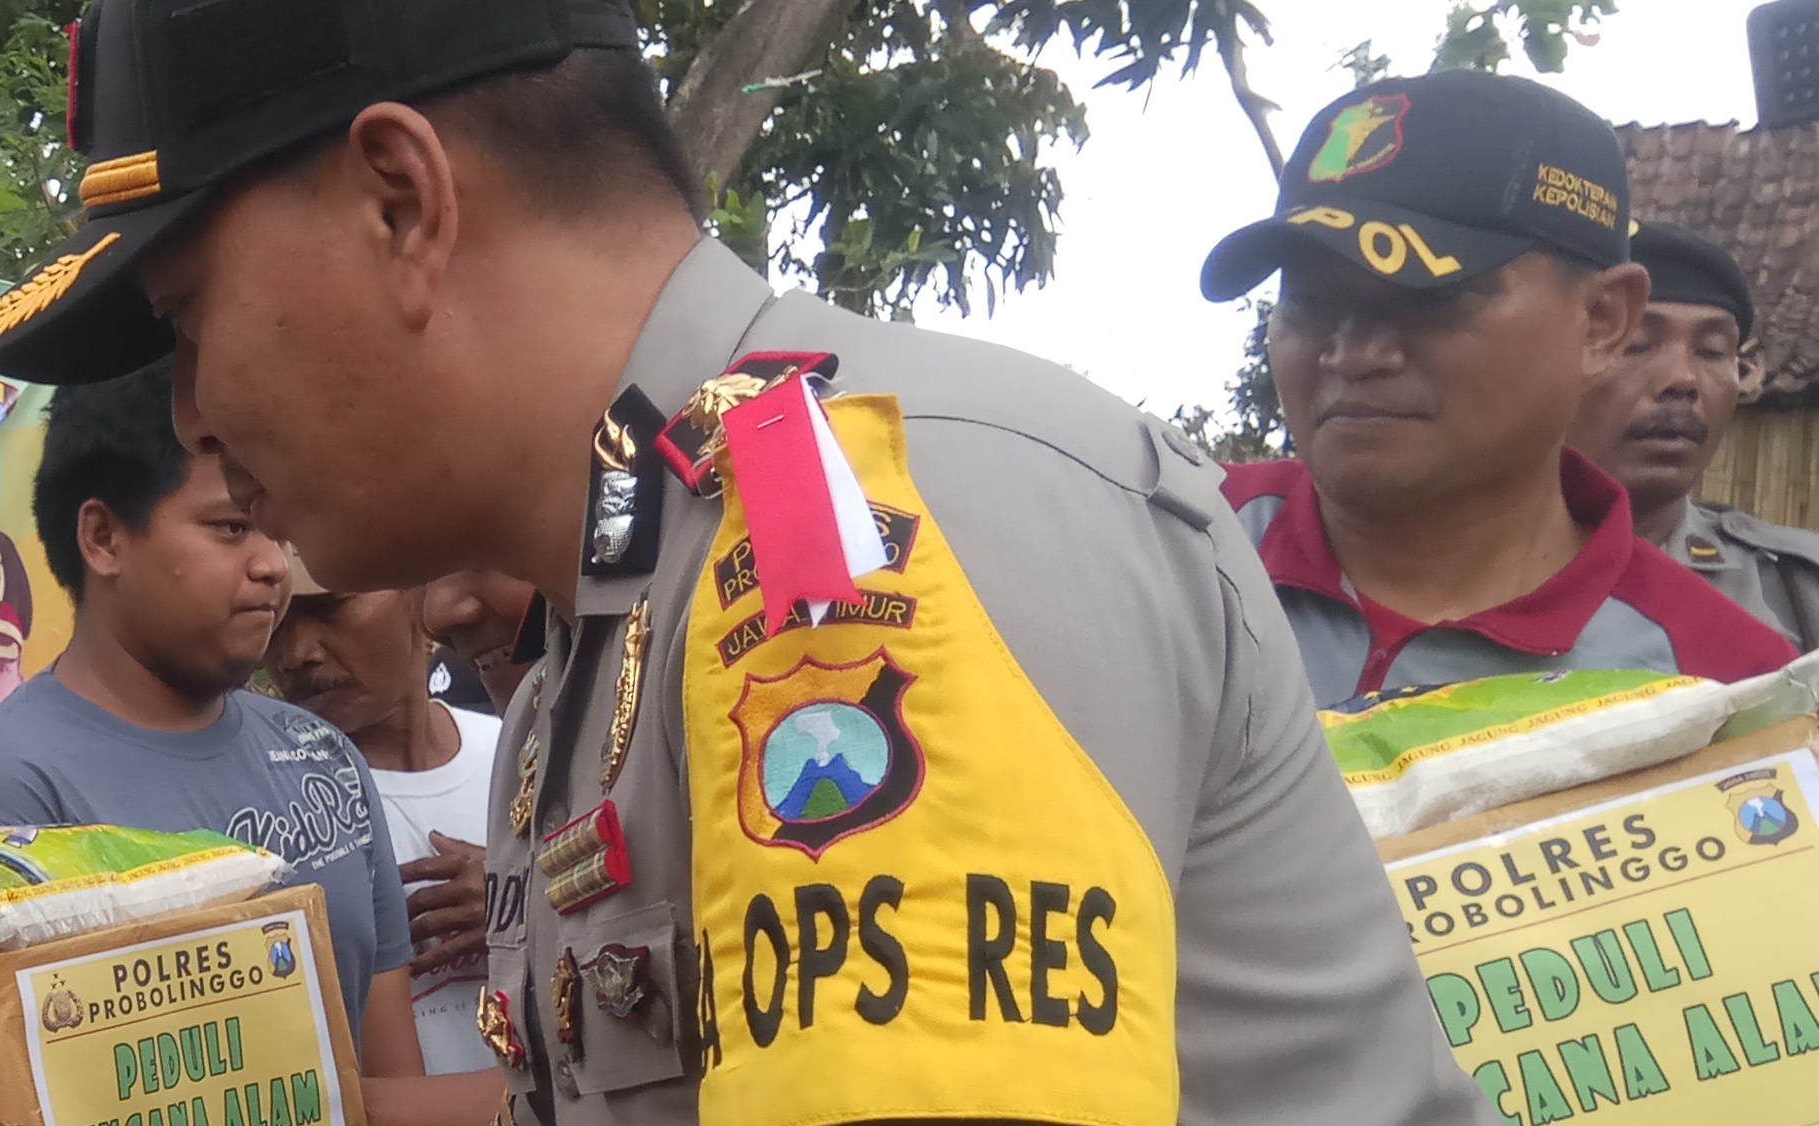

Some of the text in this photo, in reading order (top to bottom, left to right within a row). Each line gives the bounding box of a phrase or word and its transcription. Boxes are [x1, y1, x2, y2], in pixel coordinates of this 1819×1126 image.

[1286, 204, 1464, 280] POL
[1533, 184, 1616, 230] KEPOLISIAN
[833, 594, 909, 624] IMUR
[1459, 724, 1521, 748] JAGUNG
[1526, 703, 1589, 729] JAGUNG
[1595, 685, 1657, 707] JAGUNG
[1404, 813, 1658, 912] POLRES
[88, 965, 264, 1024] PROBOLINGGO
[111, 941, 232, 993] POLRES
[741, 873, 911, 1050] OPS
[964, 872, 1120, 1037] RES
[1425, 907, 1714, 1048] PEDULI
[112, 1015, 244, 1102] PEDULI
[1682, 970, 1819, 1082] ALA
